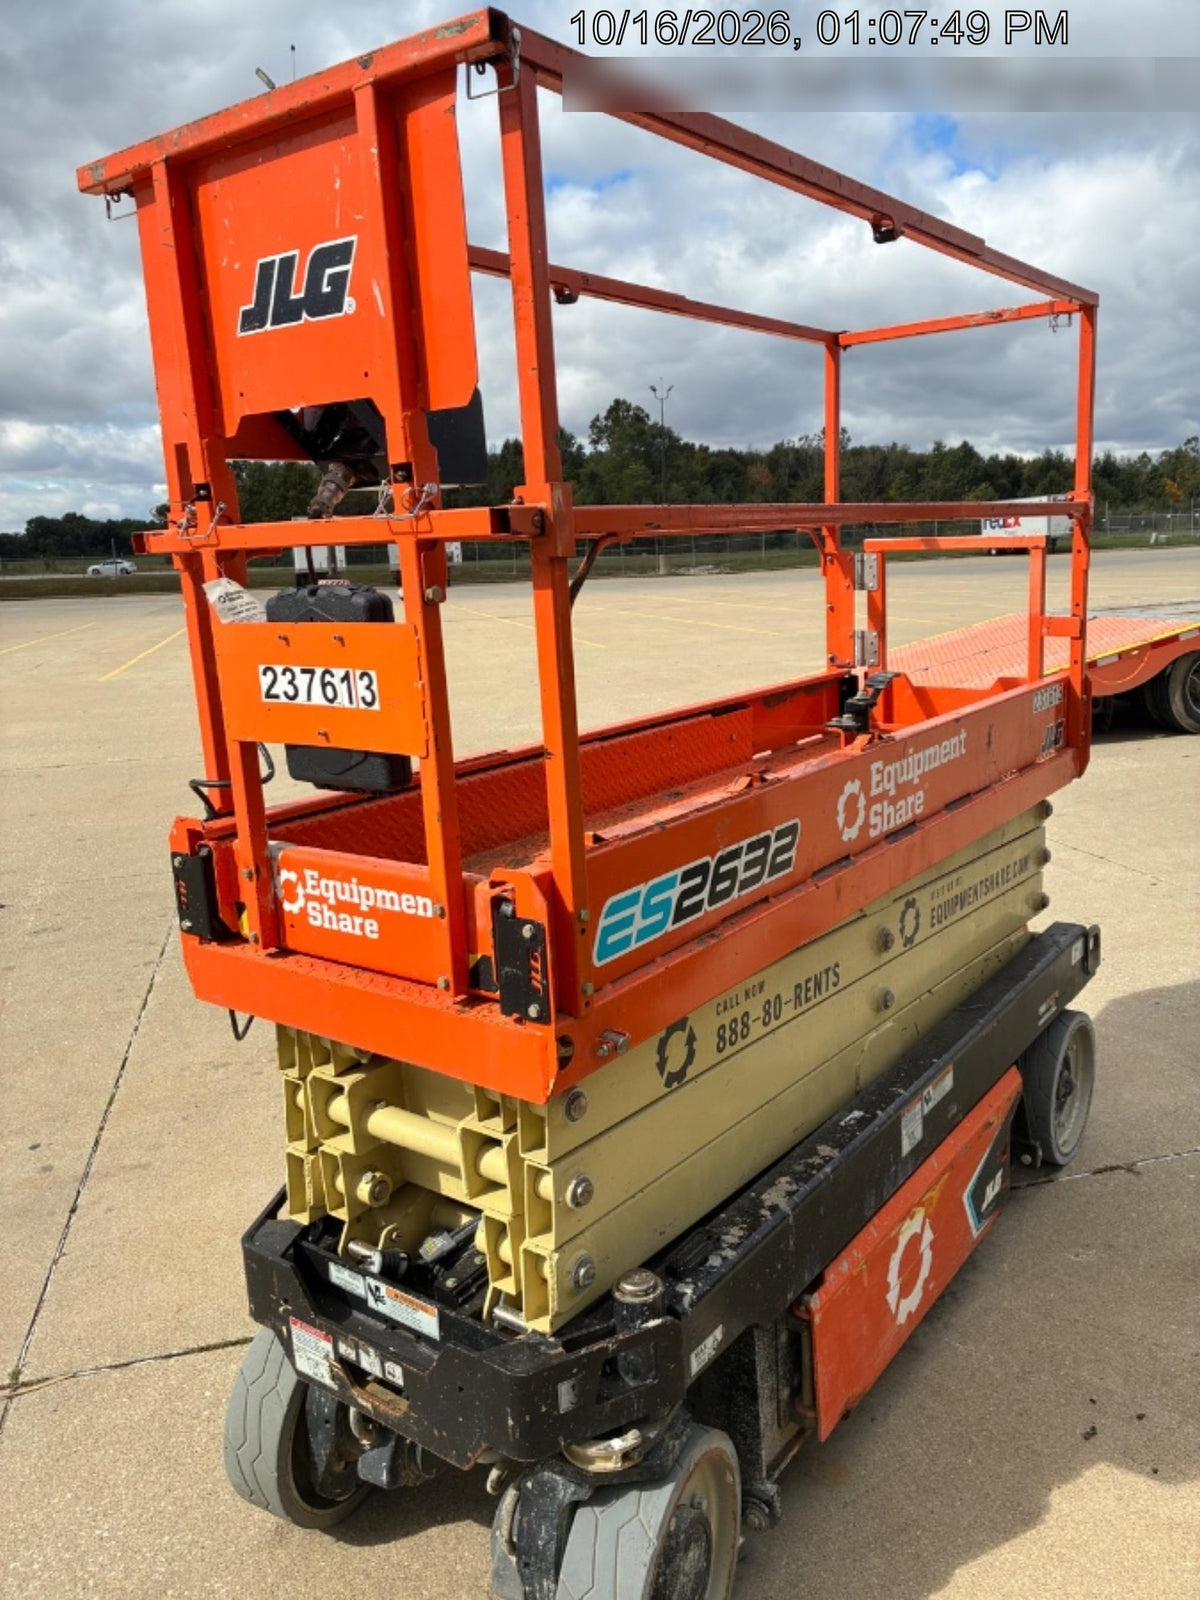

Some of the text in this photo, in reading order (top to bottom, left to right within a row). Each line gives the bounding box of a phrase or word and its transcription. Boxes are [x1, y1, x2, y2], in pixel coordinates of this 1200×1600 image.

[237, 235, 357, 337] JLG
[262, 666, 376, 707] 237613
[870, 729, 966, 797] Equipment
[869, 790, 924, 838] Share
[304, 869, 434, 918] Equipmen
[593, 818, 800, 966] ES2632
[307, 901, 379, 939] Share
[716, 979, 765, 1016] CALL NOW
[716, 961, 840, 1053] 888-80-RENTS
